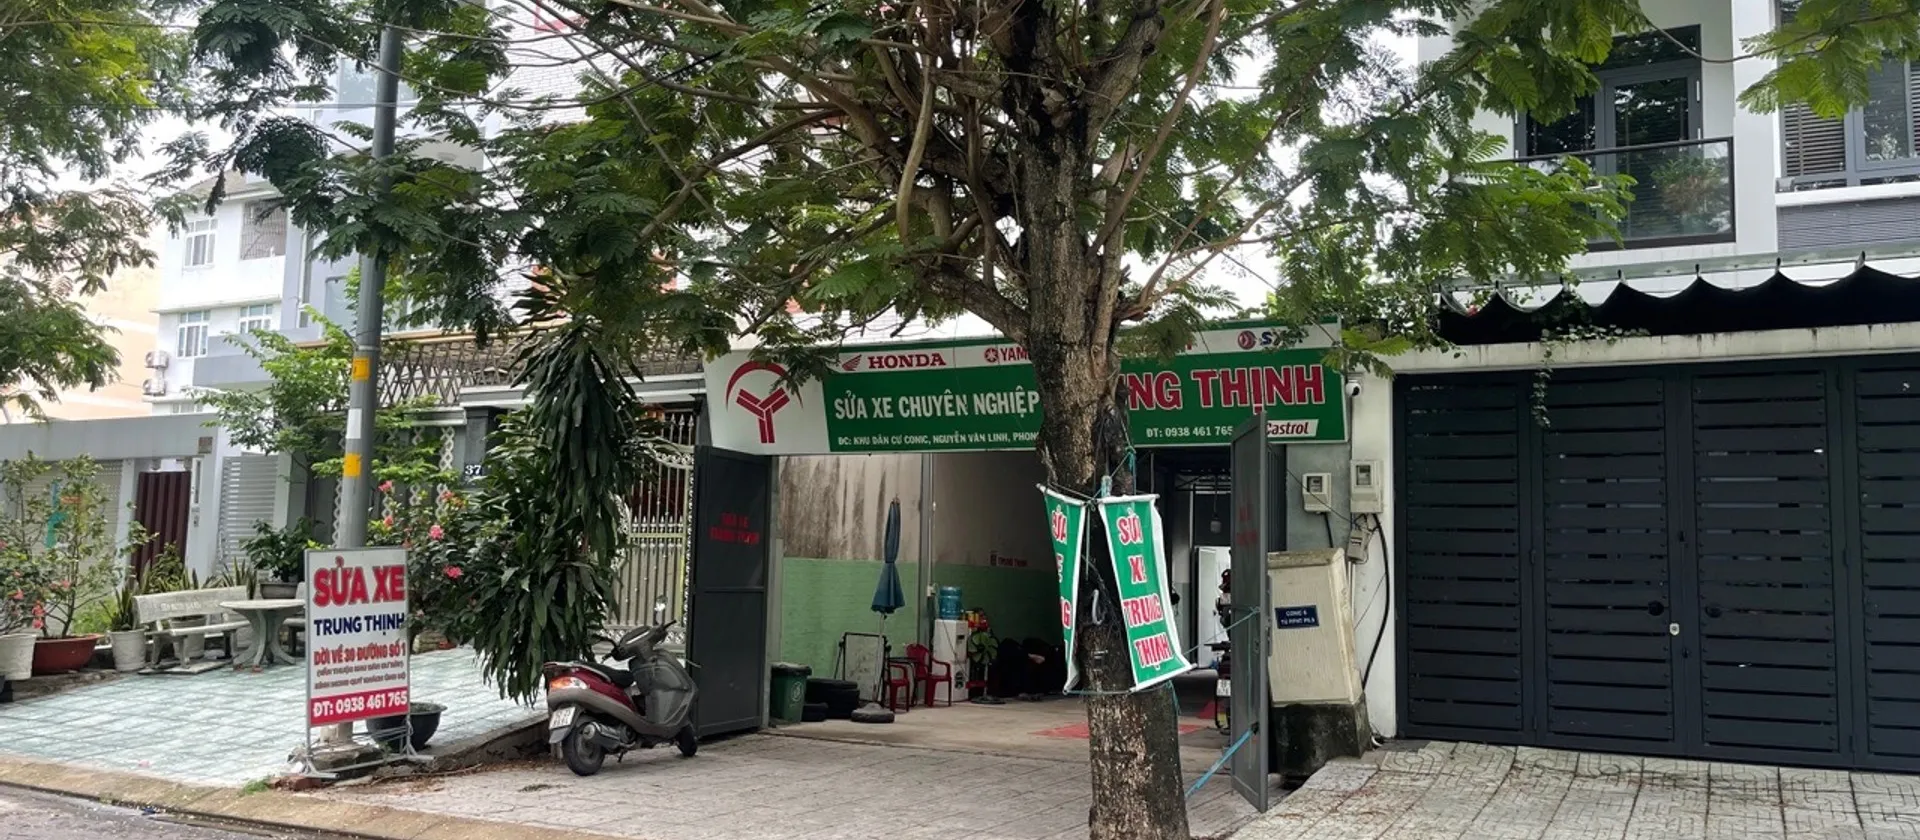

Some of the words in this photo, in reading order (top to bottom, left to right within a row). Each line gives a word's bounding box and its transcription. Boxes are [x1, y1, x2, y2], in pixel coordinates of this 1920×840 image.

[868, 352, 947, 369] HONDA
[1000, 347, 1029, 361] YAM
[1191, 364, 1325, 416] THỊNH
[835, 390, 868, 420] SỬA
[872, 397, 895, 419] XE
[898, 389, 969, 418] CHUYÊN
[973, 385, 1040, 418] NGHIỆP
[853, 436, 871, 446] KHU
[872, 434, 890, 445] DÂN
[891, 434, 902, 445] CƯ
[904, 434, 932, 447] CONIC,
[933, 430, 967, 444] NGUYỄN
[968, 432, 987, 444] VĂN
[988, 432, 1011, 444] LINH,
[1012, 431, 1040, 443] PHON
[1165, 427, 1191, 438] 0938
[1192, 426, 1212, 437] 461
[1214, 425, 1234, 436] 765
[465, 464, 481, 476] 37
[313, 555, 370, 608] SỬA
[371, 564, 406, 604] XE
[314, 616, 362, 637] TRUNG
[364, 612, 405, 636] THỊNH
[389, 638, 400, 658] SỐ
[402, 642, 406, 657] 1
[313, 700, 334, 718] ĐT:
[336, 696, 365, 715] 0938
[366, 692, 386, 710] 461
[388, 690, 408, 707] 765
